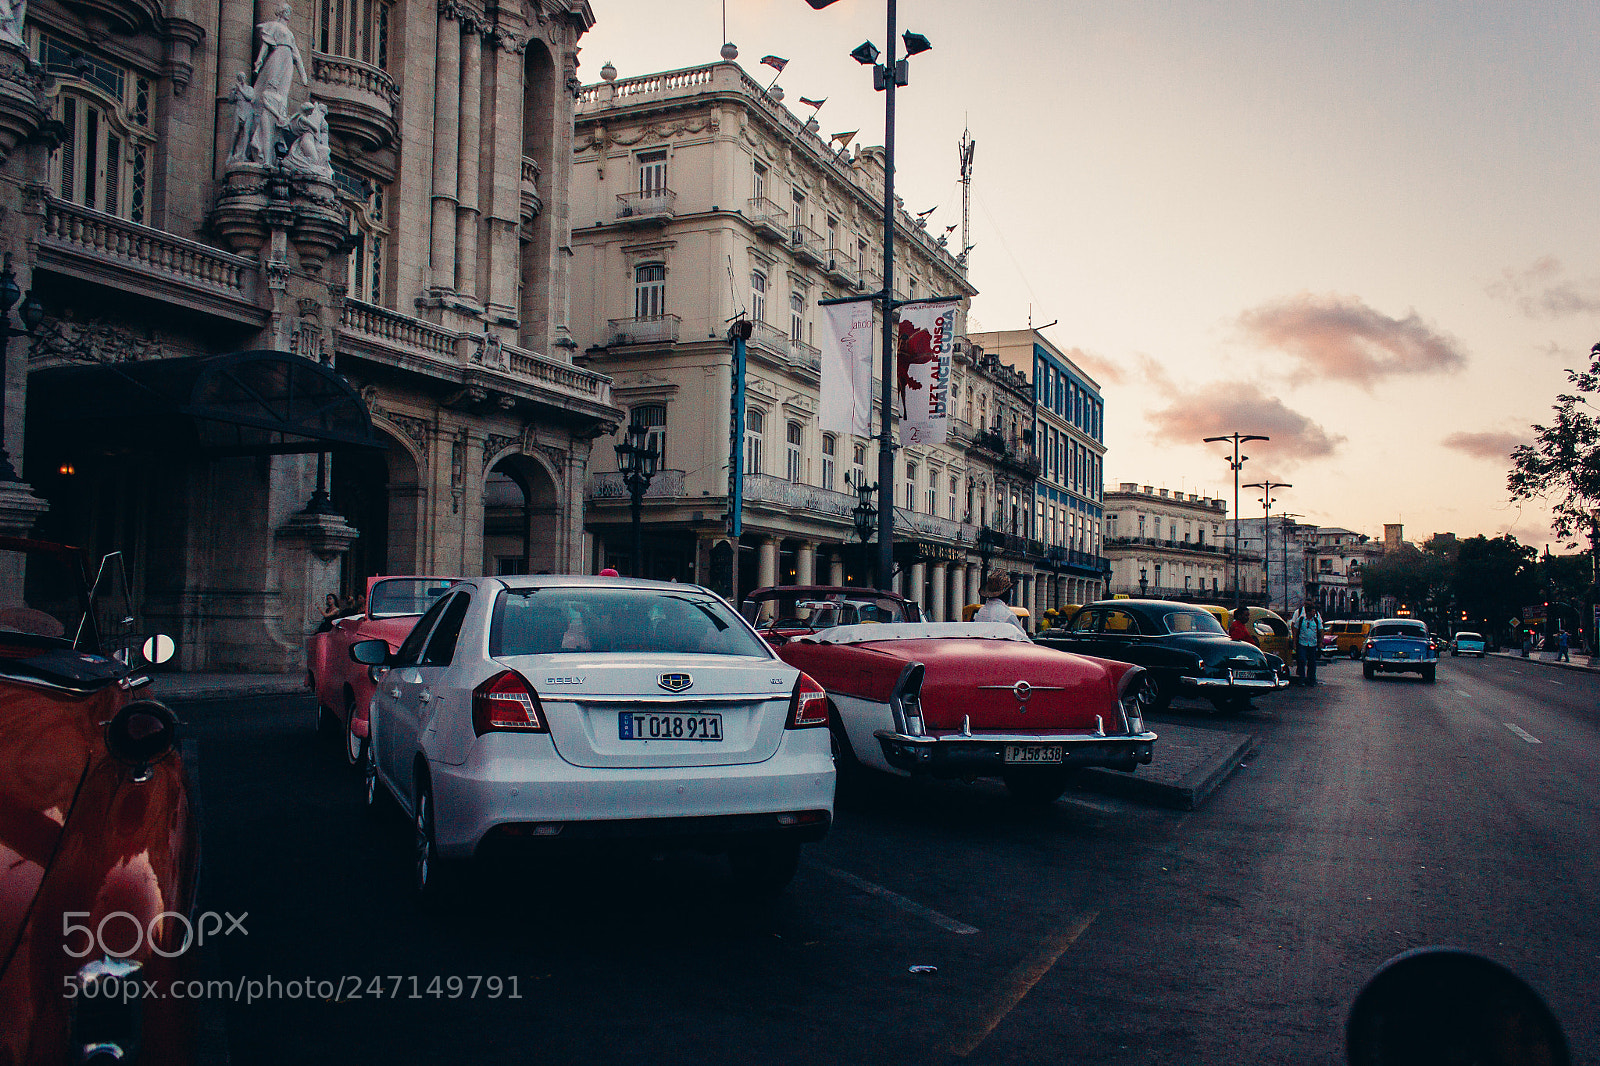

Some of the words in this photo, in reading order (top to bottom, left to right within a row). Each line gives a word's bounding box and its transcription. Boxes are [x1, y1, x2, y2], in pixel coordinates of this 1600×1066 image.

[930, 317, 944, 380] ALFONSO
[941, 309, 954, 353] CUBA
[929, 384, 940, 413] LIZT
[936, 356, 950, 413] DANCE
[545, 676, 587, 686] GEELY
